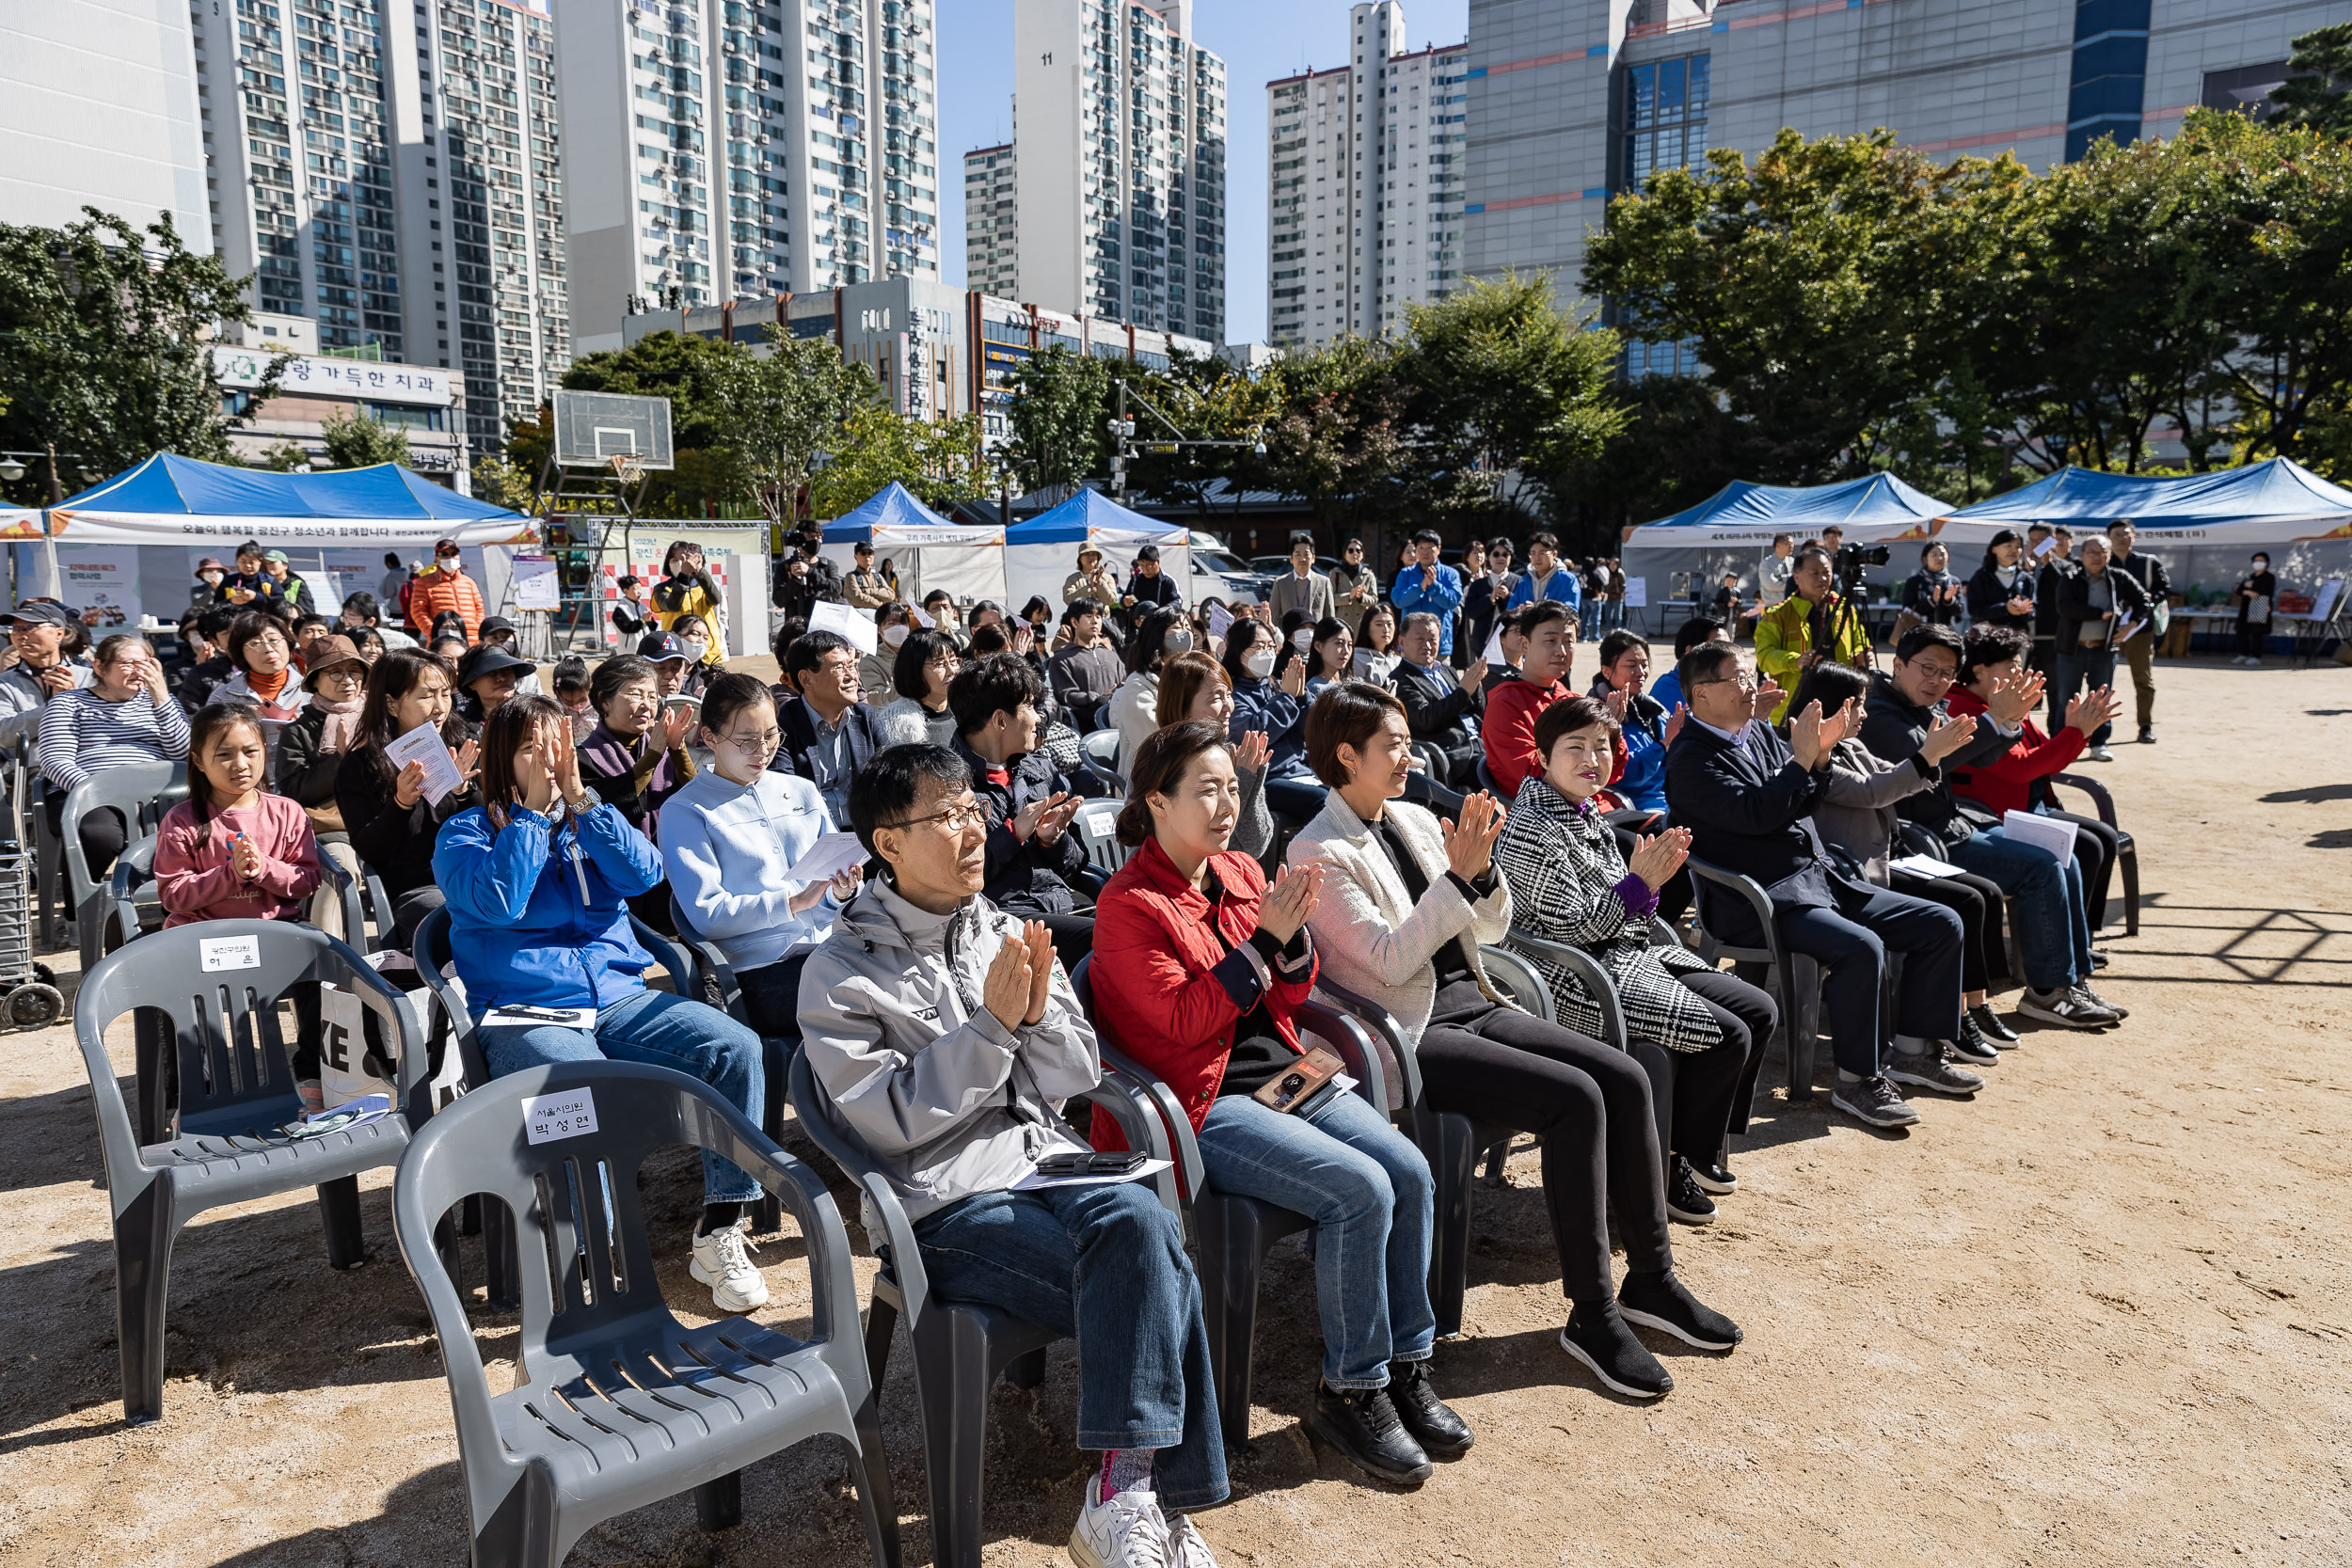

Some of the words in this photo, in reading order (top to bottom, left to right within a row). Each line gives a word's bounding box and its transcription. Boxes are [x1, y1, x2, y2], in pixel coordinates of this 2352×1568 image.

[1041, 52, 1053, 67] 11
[321, 366, 384, 388] 가득한
[395, 374, 435, 391] 치과
[182, 524, 217, 534] 오늘이
[221, 525, 254, 535] 행복할
[259, 526, 290, 536] 광진구
[294, 527, 336, 537] 청소년과
[340, 527, 389, 537] 함께합니다
[635, 548, 653, 558] 광진
[212, 945, 250, 955] 광진구의원
[536, 1101, 584, 1117] 서울시의원
[534, 1123, 548, 1135] 박
[556, 1118, 569, 1132] 성
[575, 1115, 590, 1129] 연
